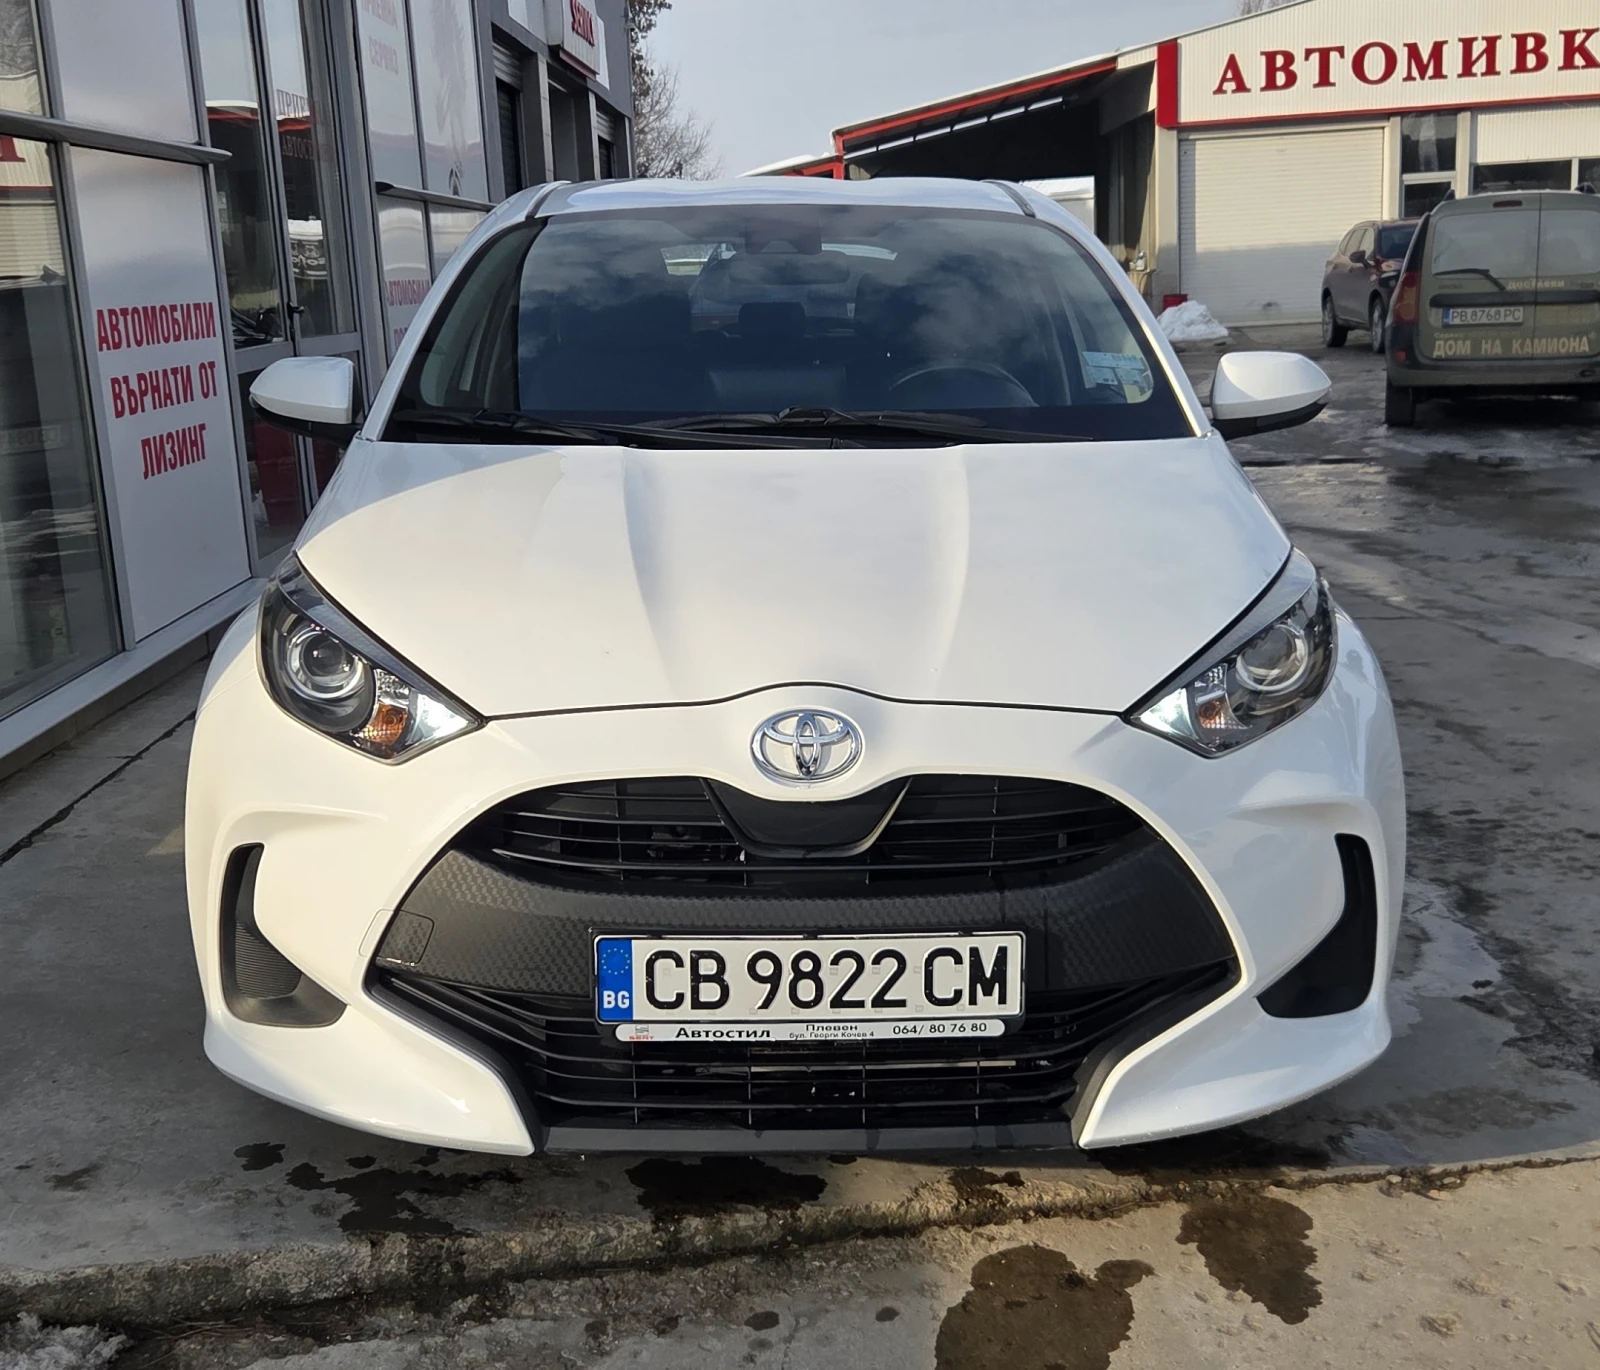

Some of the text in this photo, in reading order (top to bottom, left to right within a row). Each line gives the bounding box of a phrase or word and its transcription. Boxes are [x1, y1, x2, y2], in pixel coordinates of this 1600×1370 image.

[1450, 308, 1521, 322] PB 8768 PC
[96, 301, 217, 353] АВТОМОБИЛИ
[1432, 335, 1590, 359] ДОМ НА КАМИОНА
[109, 360, 218, 419] ВЪРНАТИ ОТ
[140, 422, 207, 480] ЛИЗИНГ
[645, 946, 1009, 1011] CB 9822 CM
[603, 990, 630, 1009] BG
[675, 1027, 771, 1039] Автостил
[805, 1023, 858, 1032] Плевен
[809, 1031, 839, 1039] Георги
[892, 1022, 988, 1036] 064/ 80 76 80
